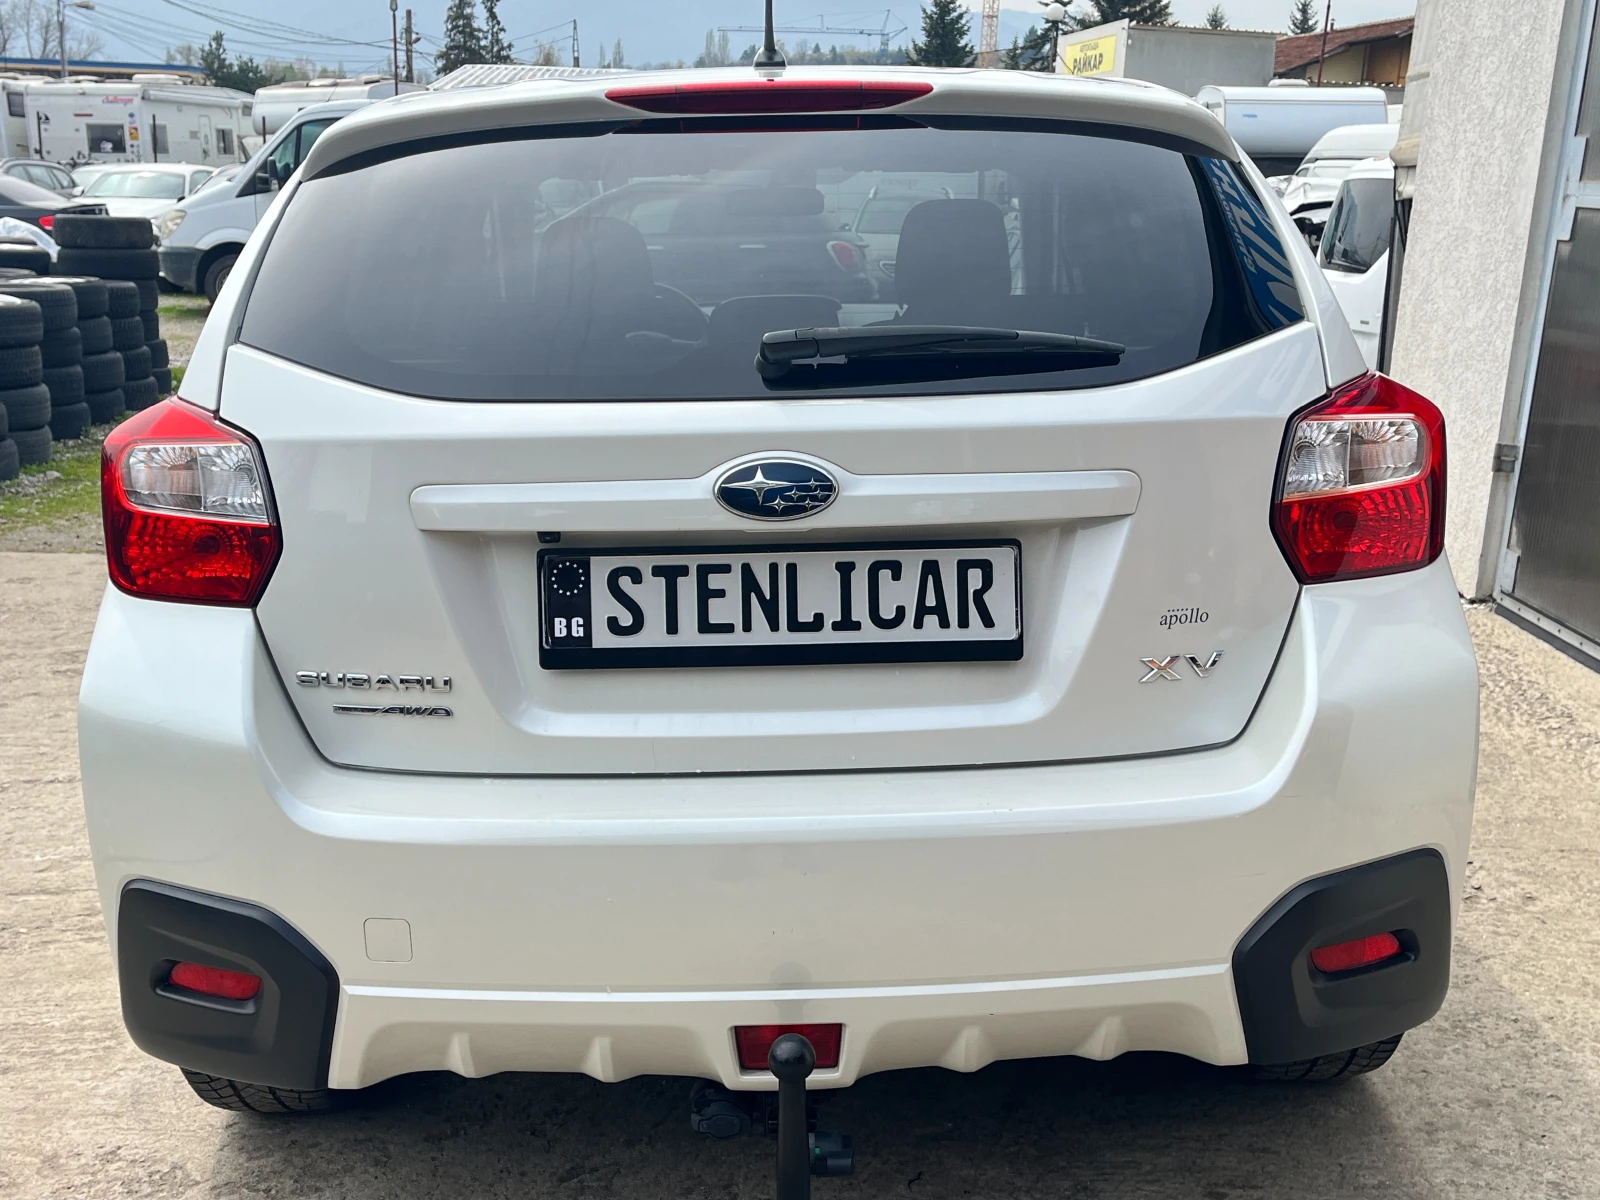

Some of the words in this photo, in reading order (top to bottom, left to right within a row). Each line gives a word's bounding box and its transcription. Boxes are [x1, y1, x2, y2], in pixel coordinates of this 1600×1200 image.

[1073, 53, 1103, 74] РАЙКАР
[605, 558, 996, 638] STENLICAR
[554, 617, 584, 637] BG
[1160, 607, 1209, 630] apollo
[1139, 650, 1225, 683] XV
[296, 671, 452, 693] SUBARU
[381, 705, 453, 717] AWD
